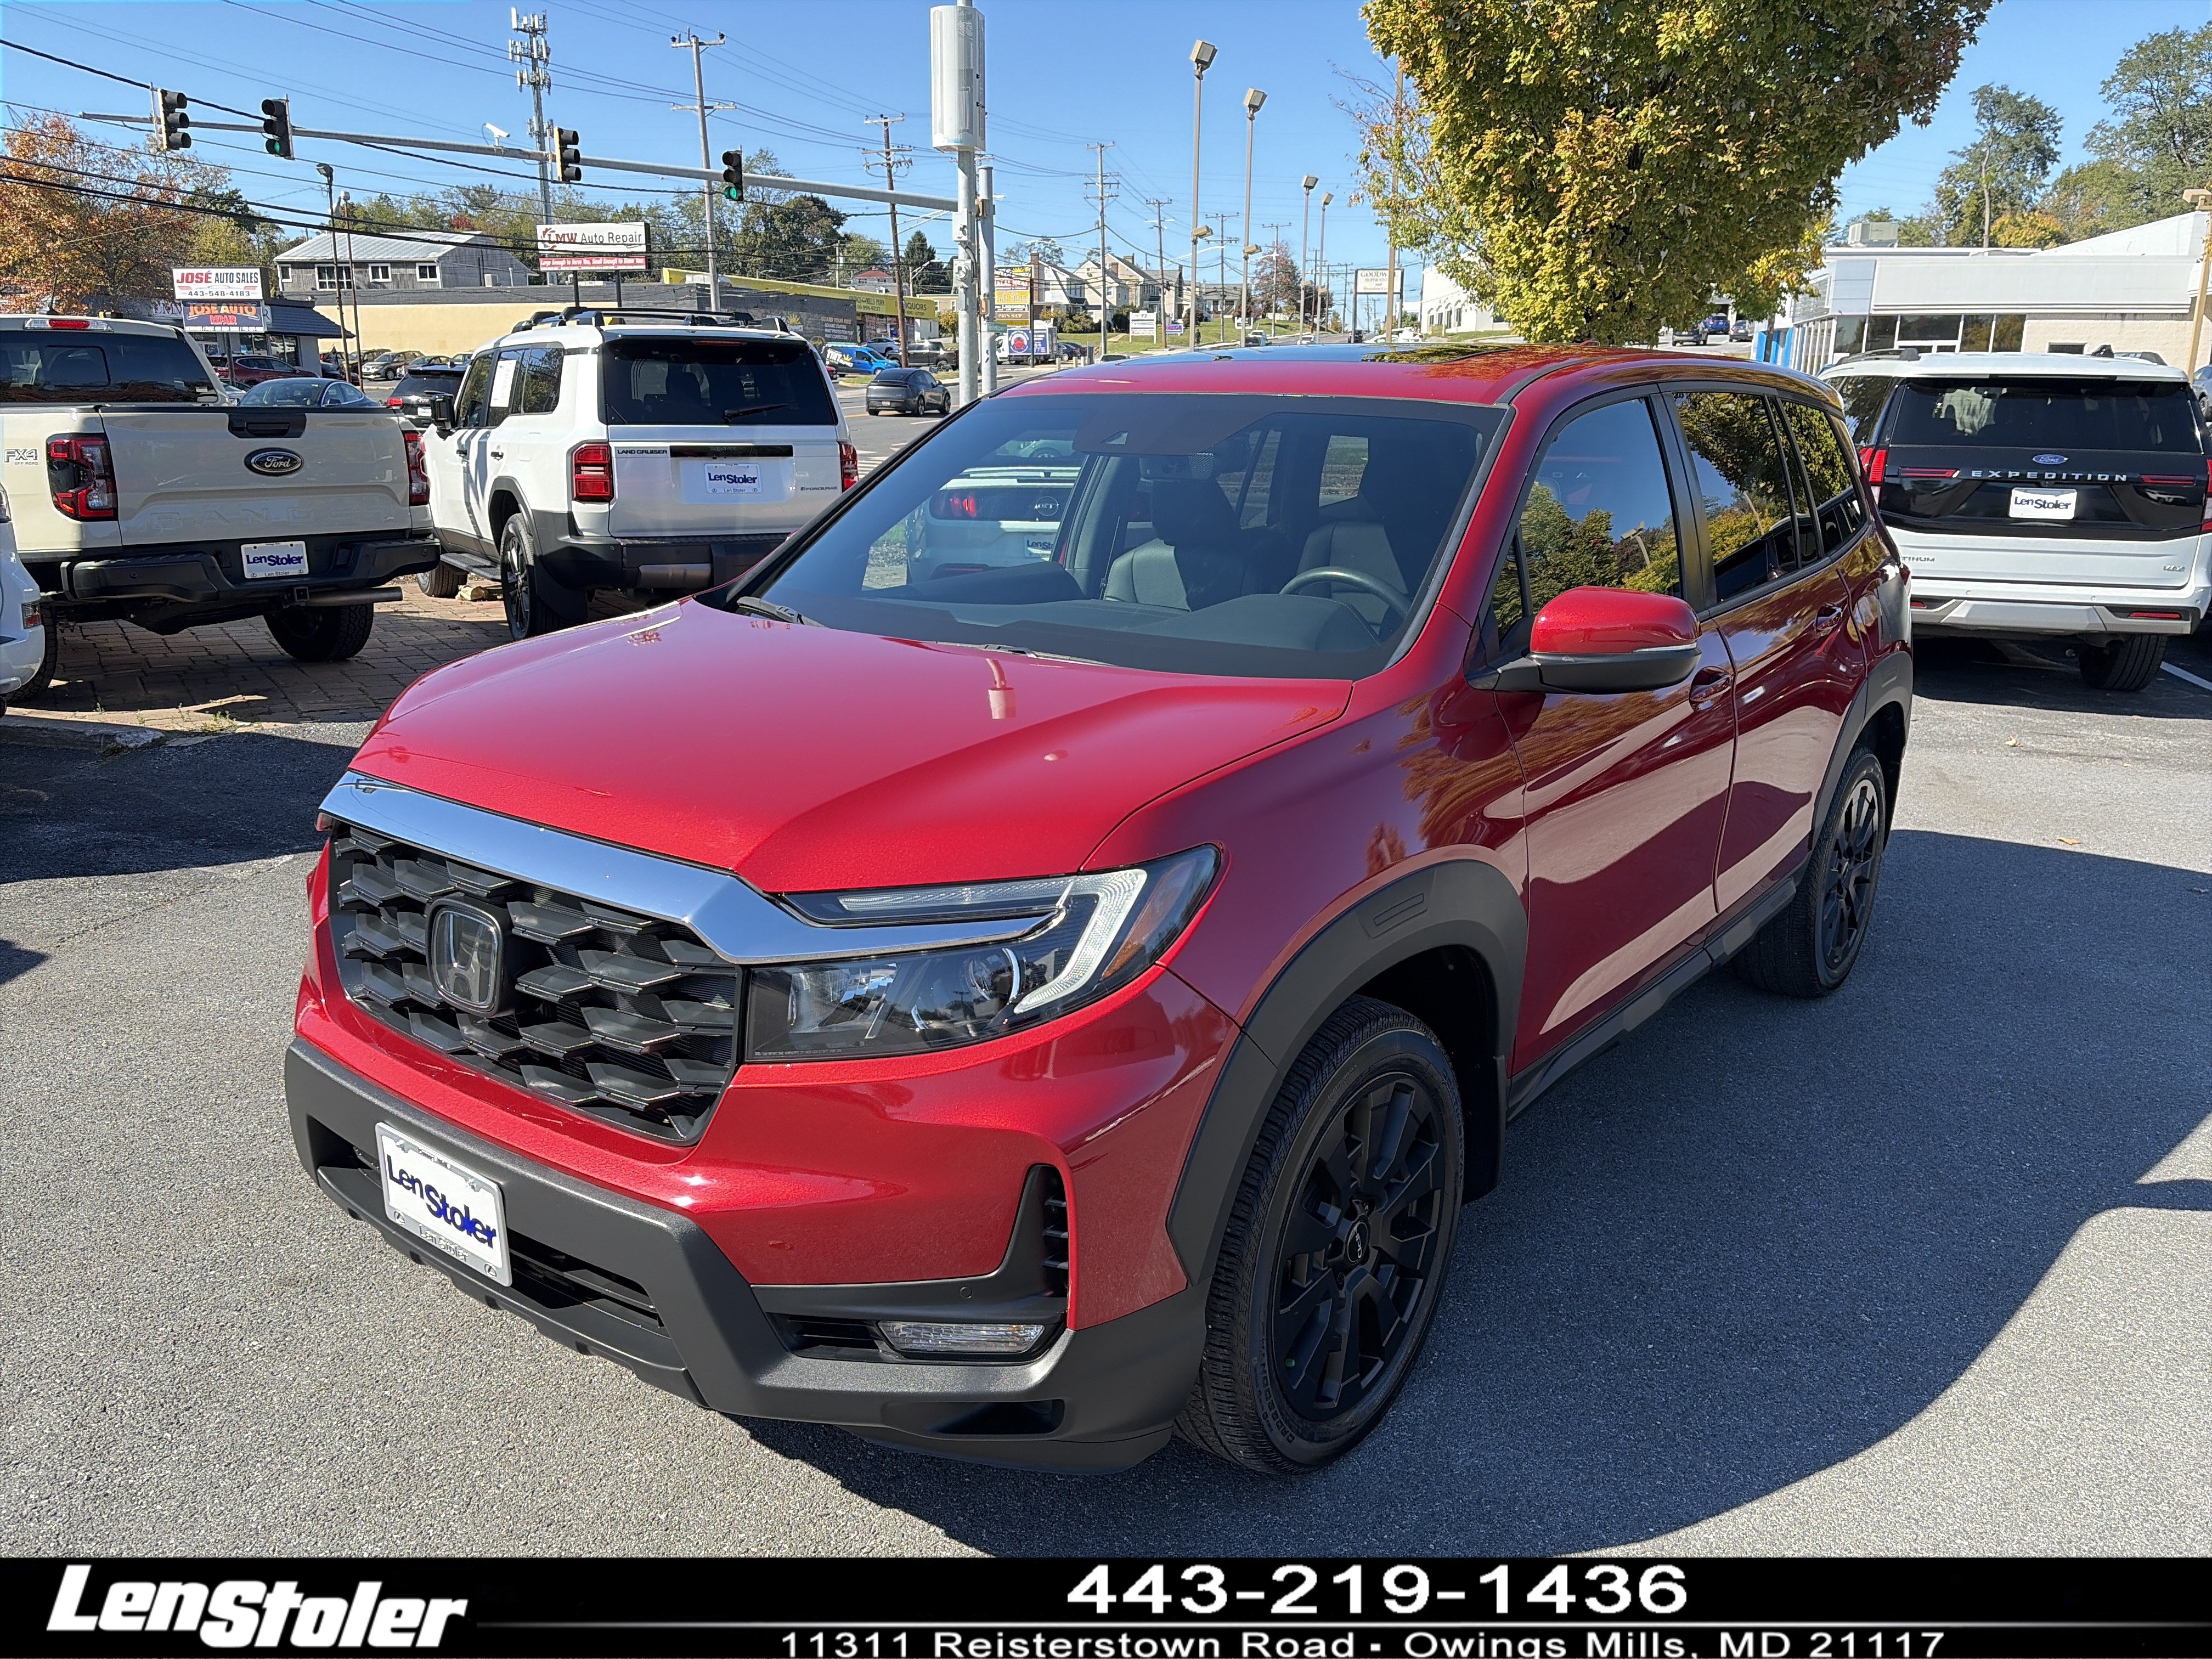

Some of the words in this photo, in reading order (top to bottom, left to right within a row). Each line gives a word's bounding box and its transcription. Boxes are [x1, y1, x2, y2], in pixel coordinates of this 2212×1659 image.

[581, 233, 605, 244] Auto
[608, 232, 642, 244] Repair
[177, 270, 212, 283] JOSÉ
[215, 272, 234, 283] AUTO
[236, 272, 258, 283] SALES
[189, 303, 218, 316] JOSE
[220, 303, 257, 316] AUTO
[905, 302, 927, 311] IQUORS
[4, 449, 38, 463] FX4
[264, 455, 291, 468] Ford
[2040, 455, 2059, 463] Ford
[1971, 470, 2127, 482] EXPEDITION
[438, 1235, 469, 1262] Stoler
